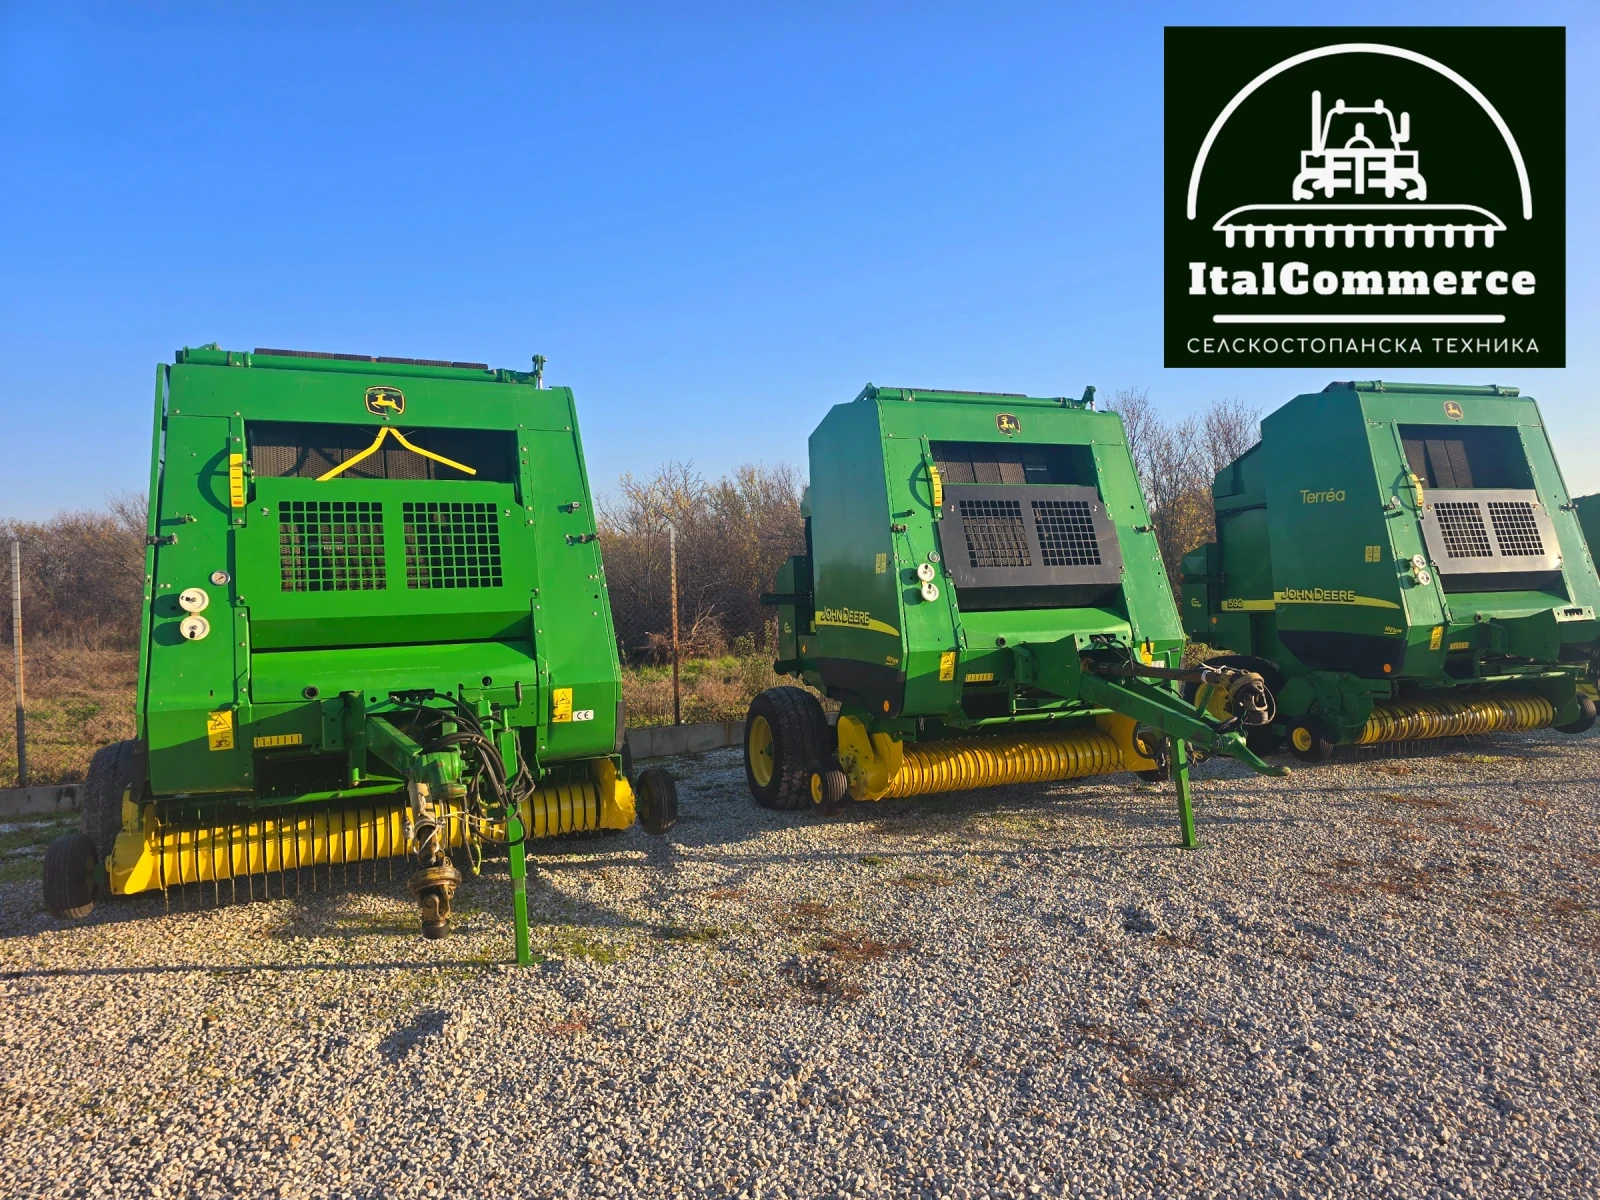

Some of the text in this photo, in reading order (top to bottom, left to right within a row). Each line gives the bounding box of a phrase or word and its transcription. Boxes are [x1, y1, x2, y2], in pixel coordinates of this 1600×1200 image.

[1300, 488, 1345, 504] Terréa
[1281, 587, 1355, 601] JOHN DEERE
[1227, 598, 1244, 609] 592
[821, 605, 870, 626] JOHN DEERE
